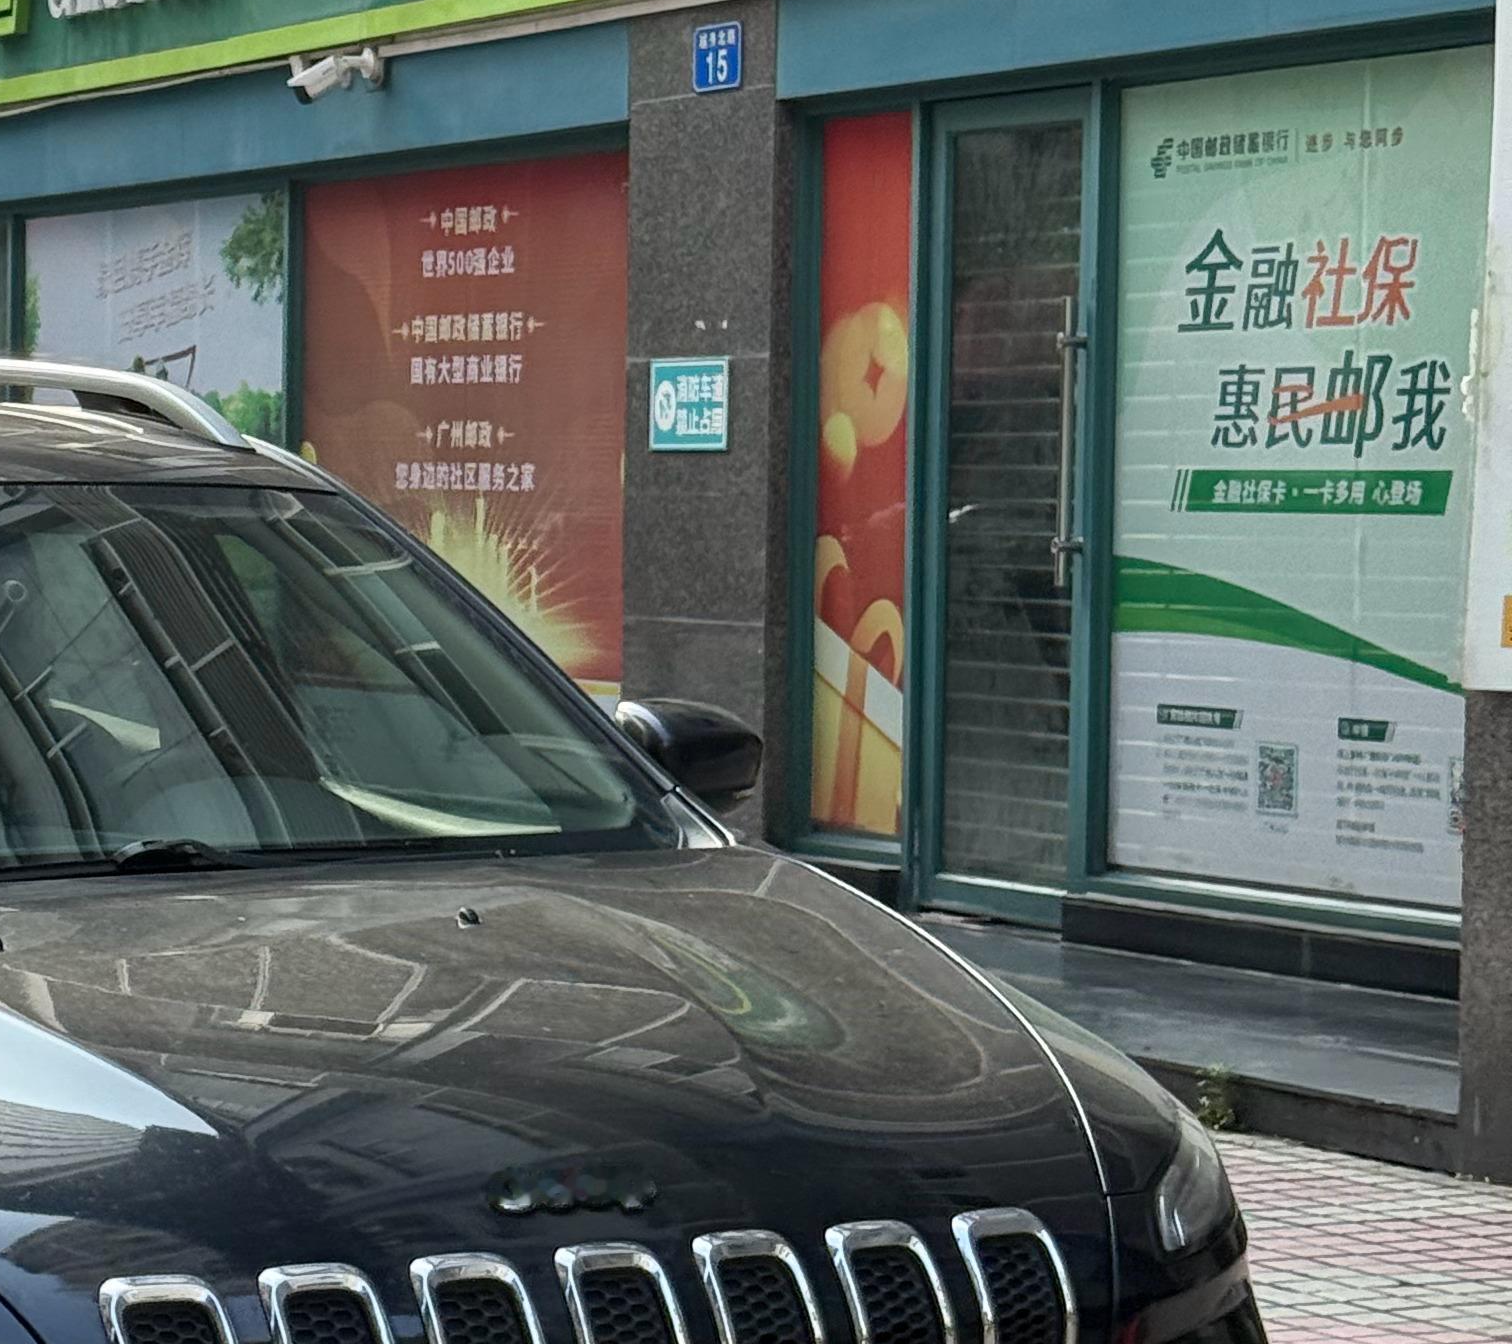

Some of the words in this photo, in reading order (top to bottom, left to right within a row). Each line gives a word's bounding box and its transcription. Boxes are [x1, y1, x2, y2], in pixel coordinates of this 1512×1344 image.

[706, 48, 728, 84] 15
[440, 205, 497, 236] 中国邮政
[421, 245, 515, 278] 世界500强企业
[1177, 228, 1419, 334] 金融社保
[411, 312, 524, 344] 中国邮政储蓄银行
[410, 354, 523, 384] 国有大型商业银行
[1210, 350, 1451, 458] 惠民邮我
[436, 420, 493, 449] 广州邮政
[395, 461, 536, 492] 您身边的社区服务之家
